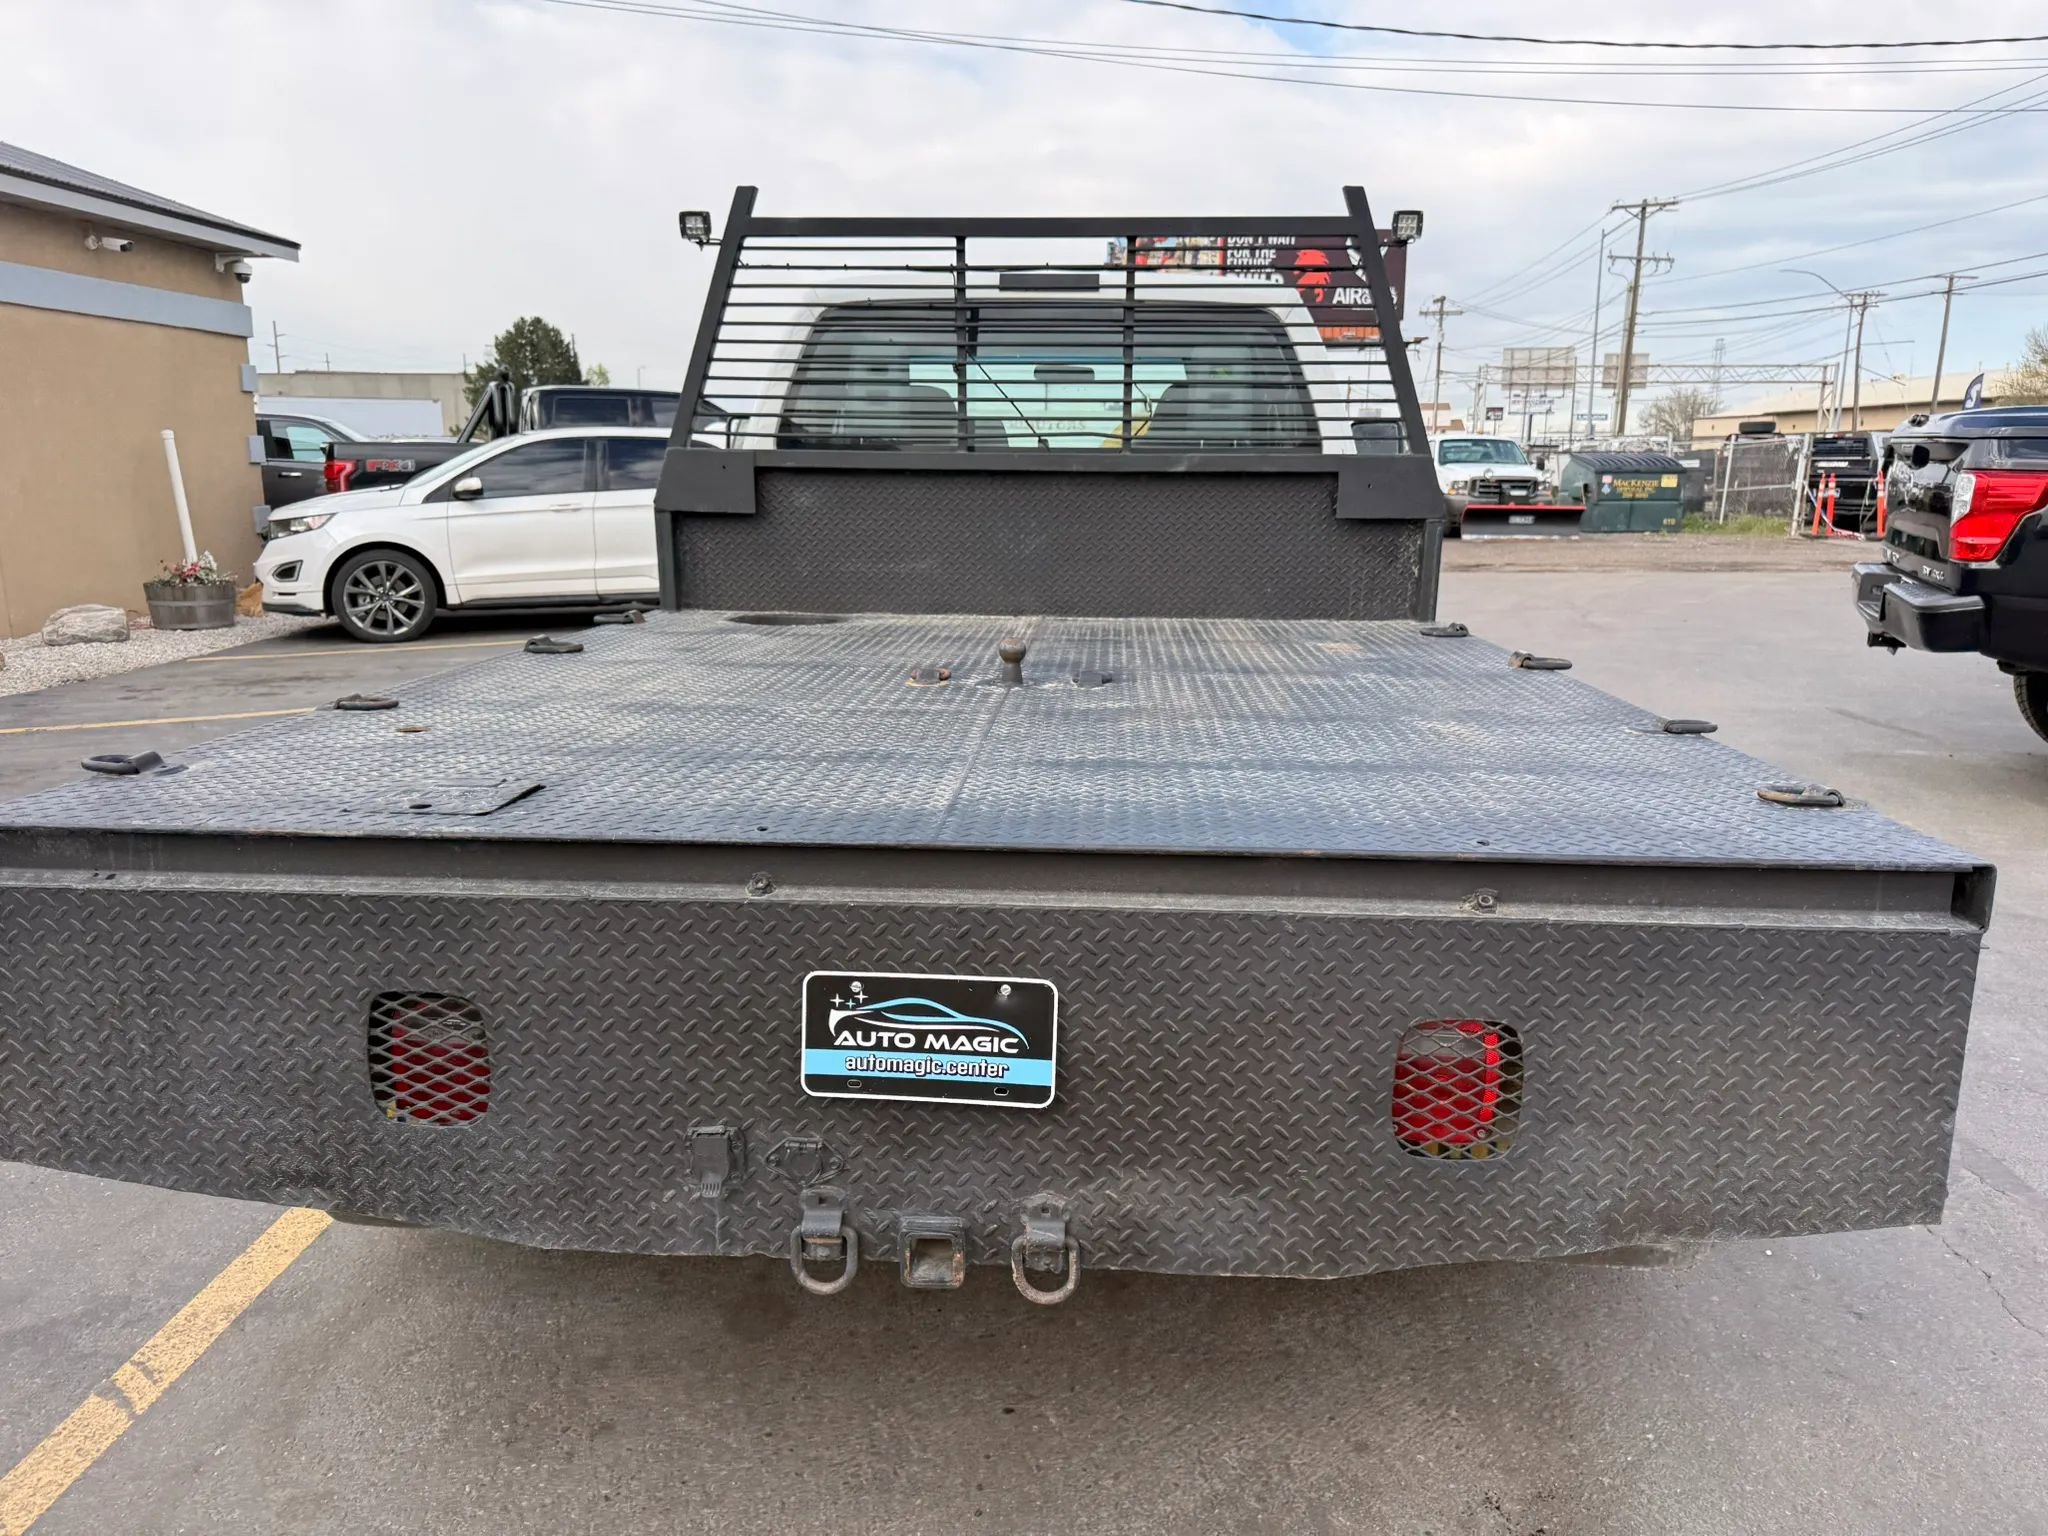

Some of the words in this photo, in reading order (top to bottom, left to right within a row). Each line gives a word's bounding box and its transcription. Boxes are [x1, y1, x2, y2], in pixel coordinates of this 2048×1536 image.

[1227, 235, 1264, 247] DONT
[1226, 248, 1250, 258] FOR
[1254, 248, 1277, 258] THE
[1332, 287, 1361, 305] AIR
[366, 459, 416, 472] FX4
[833, 1030, 916, 1049] AUTO
[924, 1033, 1020, 1054] MAGIC
[844, 1054, 1010, 1079] automagic.center
